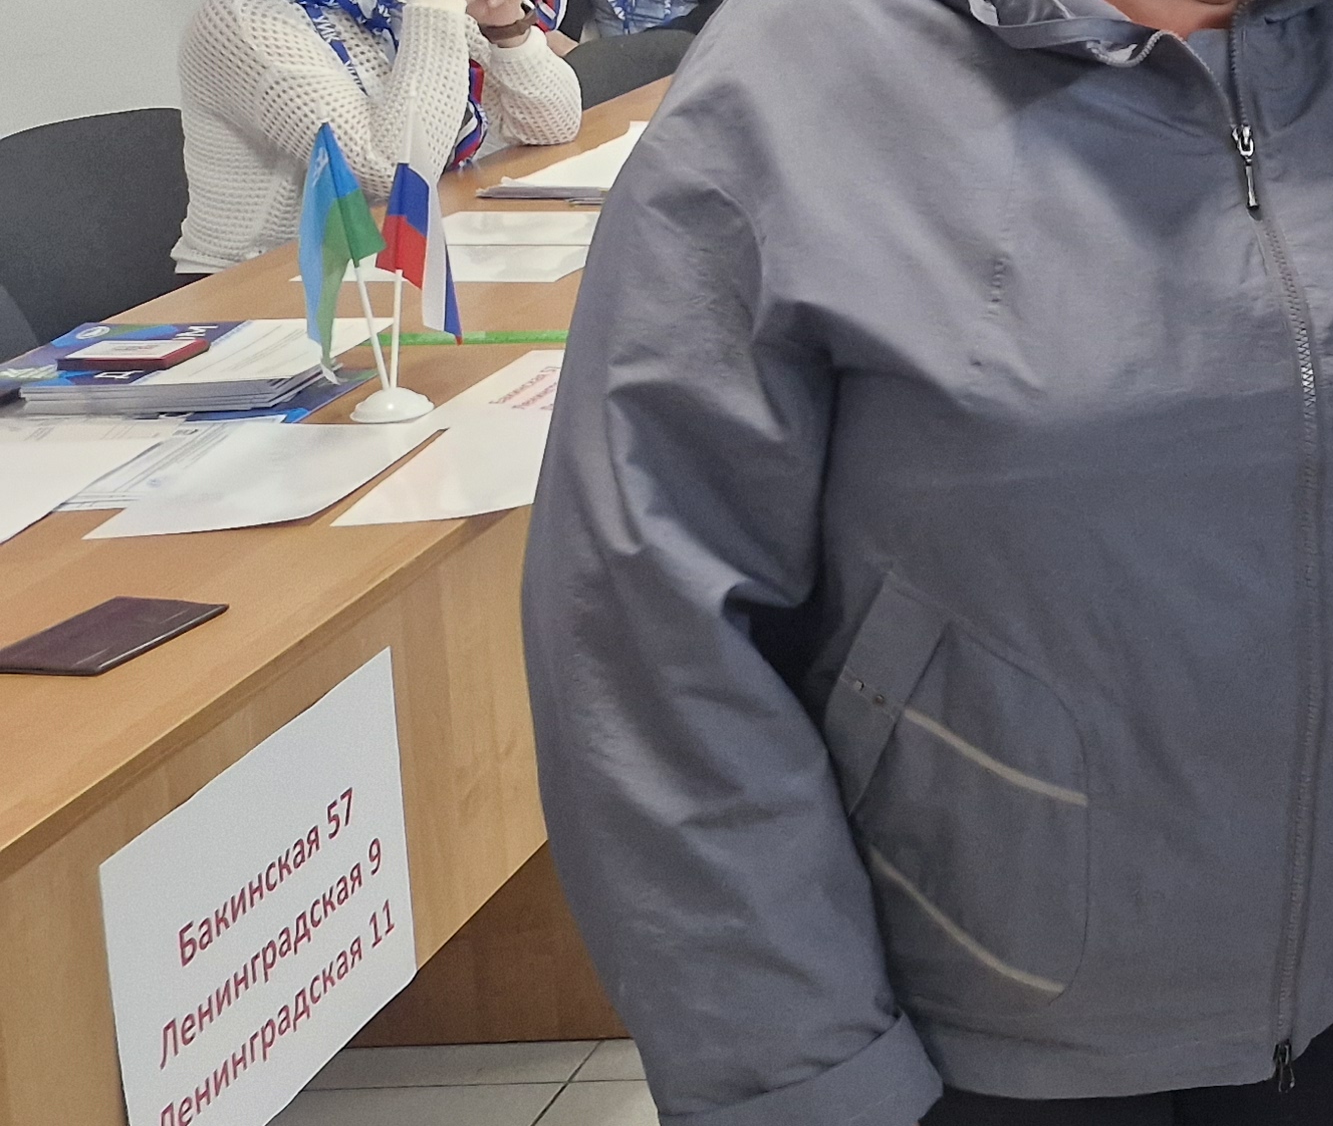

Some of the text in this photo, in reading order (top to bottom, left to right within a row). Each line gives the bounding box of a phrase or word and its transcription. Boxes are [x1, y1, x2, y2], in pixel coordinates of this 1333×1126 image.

[160, 838, 382, 1069] Ленинградская 9
[179, 788, 354, 966] Бакинская 57
[160, 900, 396, 1126] Ленинградская 11
